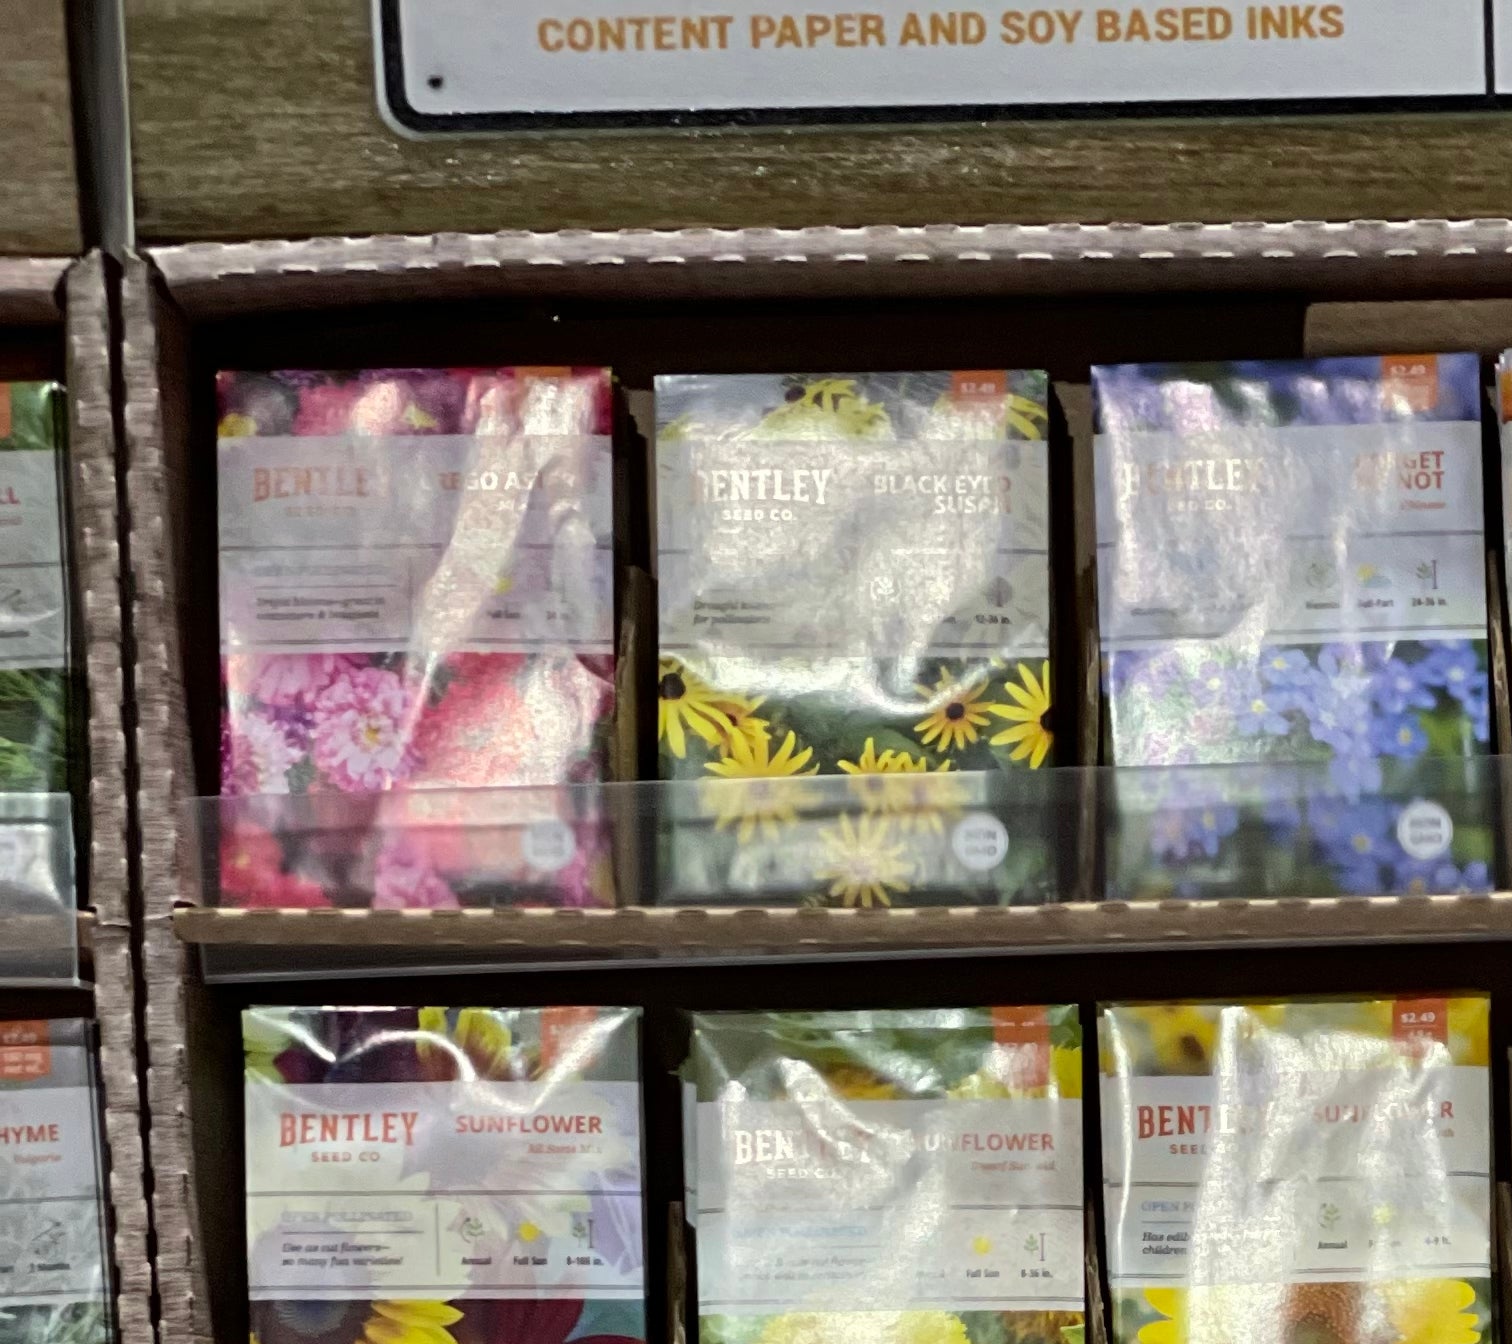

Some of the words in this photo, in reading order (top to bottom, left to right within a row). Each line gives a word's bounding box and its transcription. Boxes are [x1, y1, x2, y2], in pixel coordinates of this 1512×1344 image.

[538, 16, 731, 50] CONTENT
[750, 14, 885, 47] PAPER
[901, 12, 986, 44] AND
[1002, 11, 1080, 44] SOY
[1097, 7, 1232, 41] BASED
[1247, 6, 1342, 37] INKS
[1398, 470, 1445, 490] NOT
[722, 509, 764, 521] SEED
[1401, 1012, 1435, 1023] $2.49
[280, 1111, 417, 1146] BENTLEY
[456, 1115, 601, 1134] SUNFLOWER
